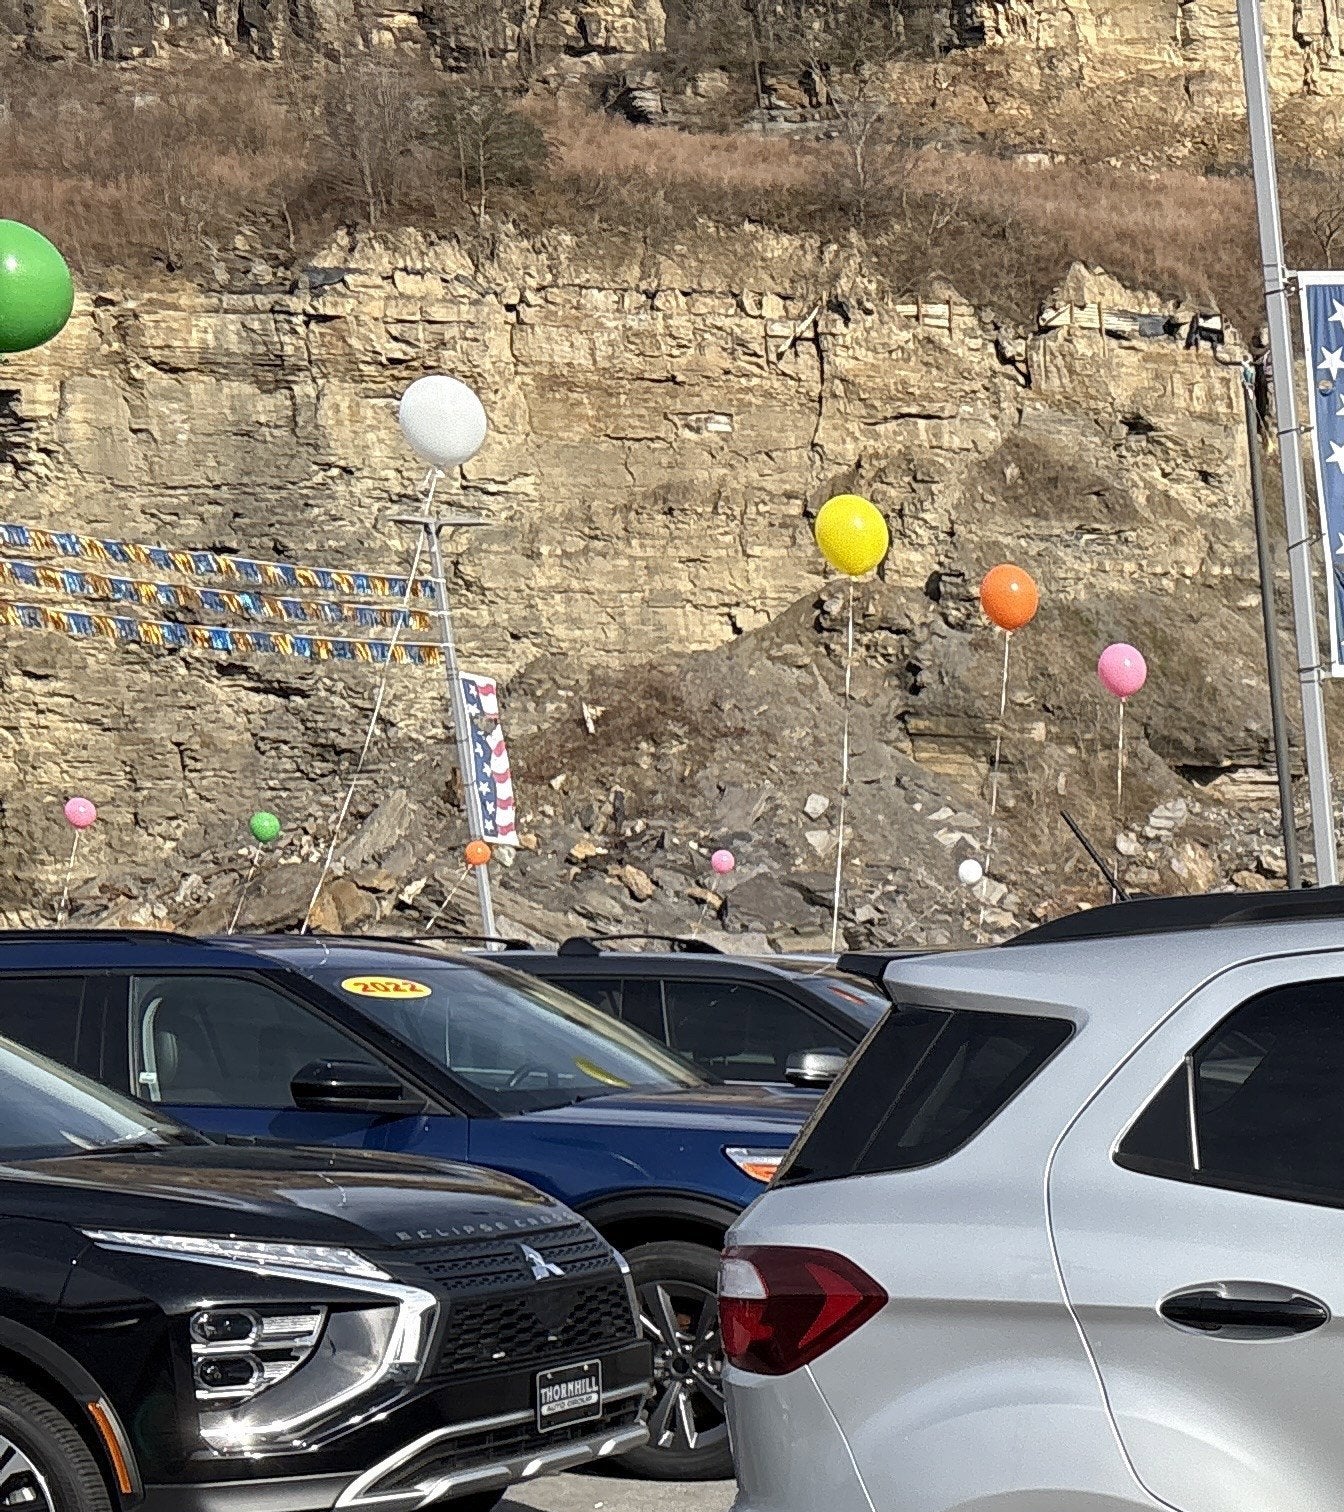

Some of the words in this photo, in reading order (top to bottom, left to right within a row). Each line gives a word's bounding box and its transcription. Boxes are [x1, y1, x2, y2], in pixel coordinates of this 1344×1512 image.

[353, 981, 423, 993] 2022
[395, 1221, 508, 1242] ECLIPSE
[540, 1376, 599, 1404] THORNHILL
